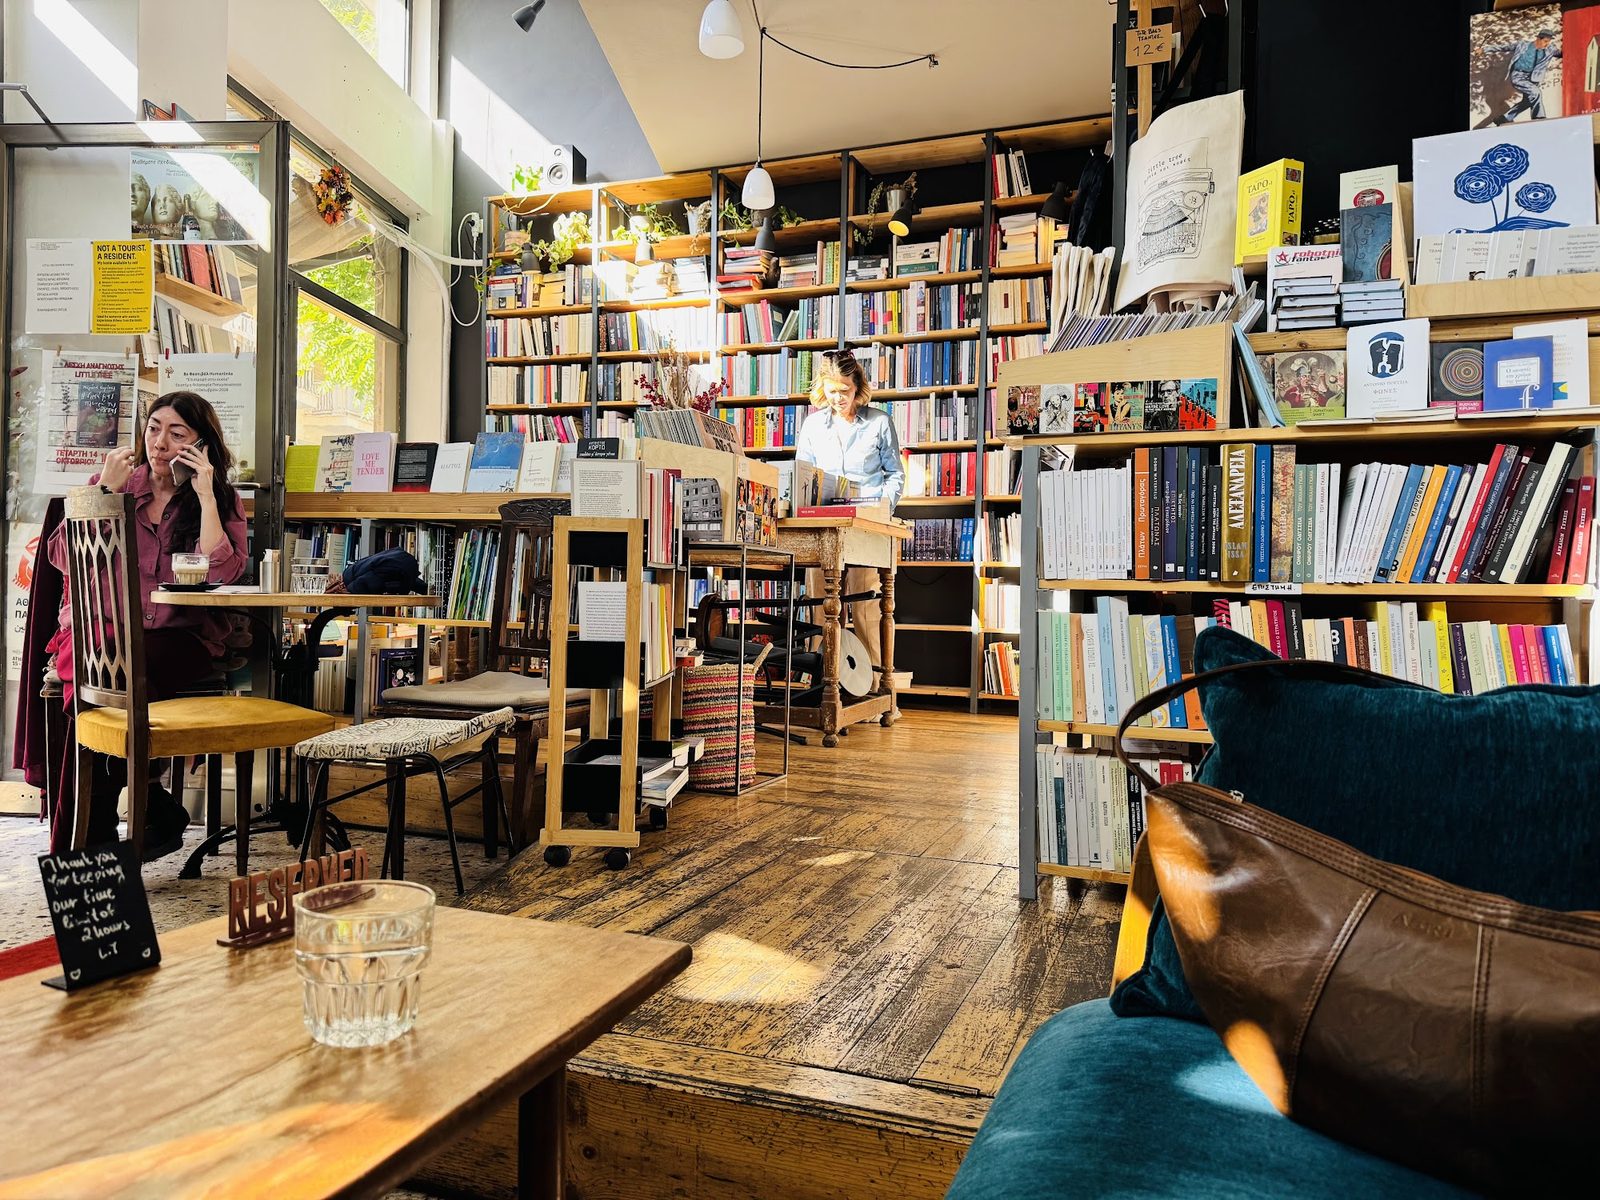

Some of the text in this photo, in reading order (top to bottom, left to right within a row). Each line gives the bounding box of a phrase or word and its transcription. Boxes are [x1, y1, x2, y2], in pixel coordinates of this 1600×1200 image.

[97, 244, 146, 252] NOT A TOURIST.
[56, 449, 98, 458] ΤΕΤΑΡΤΗ 14
[362, 452, 380, 460] LOVE
[357, 468, 385, 476] TENDER
[1138, 479, 1146, 558] Πλάτων Πρωταγόρας
[41, 852, 118, 872] Thank you
[53, 888, 115, 913] our time
[229, 848, 369, 939] RESERVED
[62, 903, 115, 929] limit of
[82, 920, 130, 942] 2 hours
